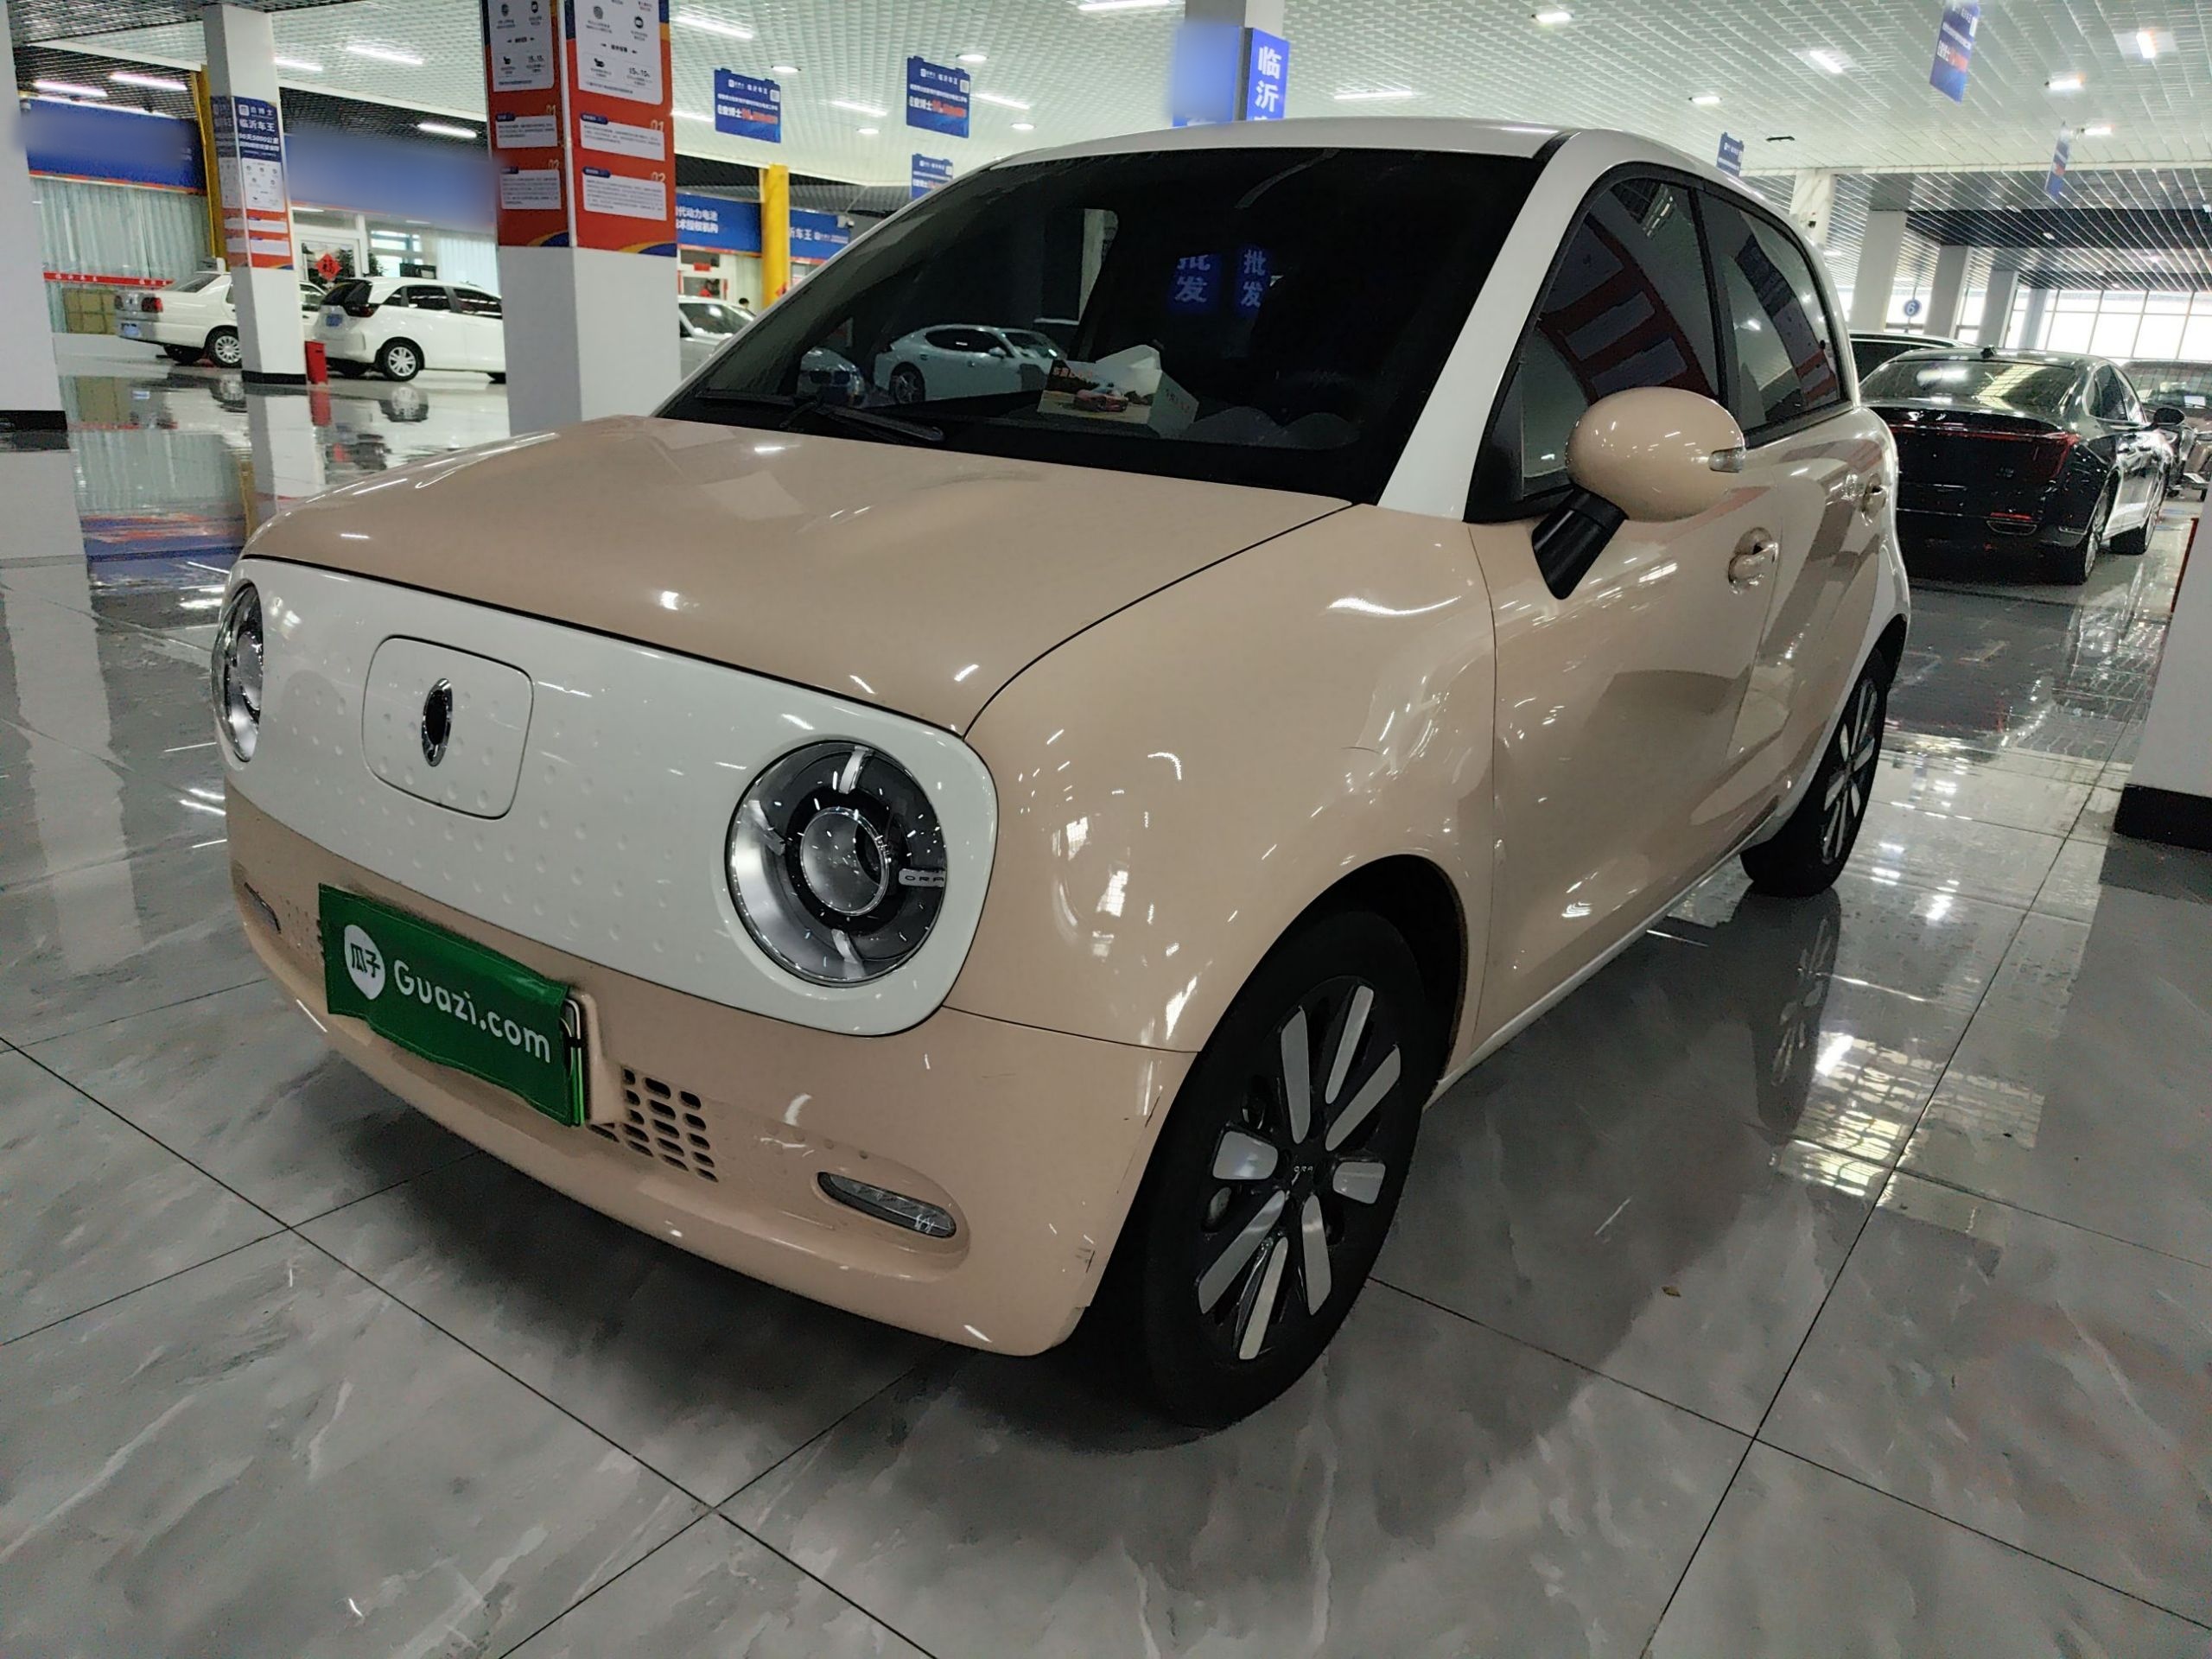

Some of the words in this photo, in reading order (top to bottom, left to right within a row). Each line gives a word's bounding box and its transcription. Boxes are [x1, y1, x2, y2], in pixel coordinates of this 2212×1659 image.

[1255, 46, 1282, 120] 临沂
[238, 118, 276, 132] 临沂车王
[350, 943, 381, 978] 瓜子
[394, 959, 550, 1064] Guazi.com
